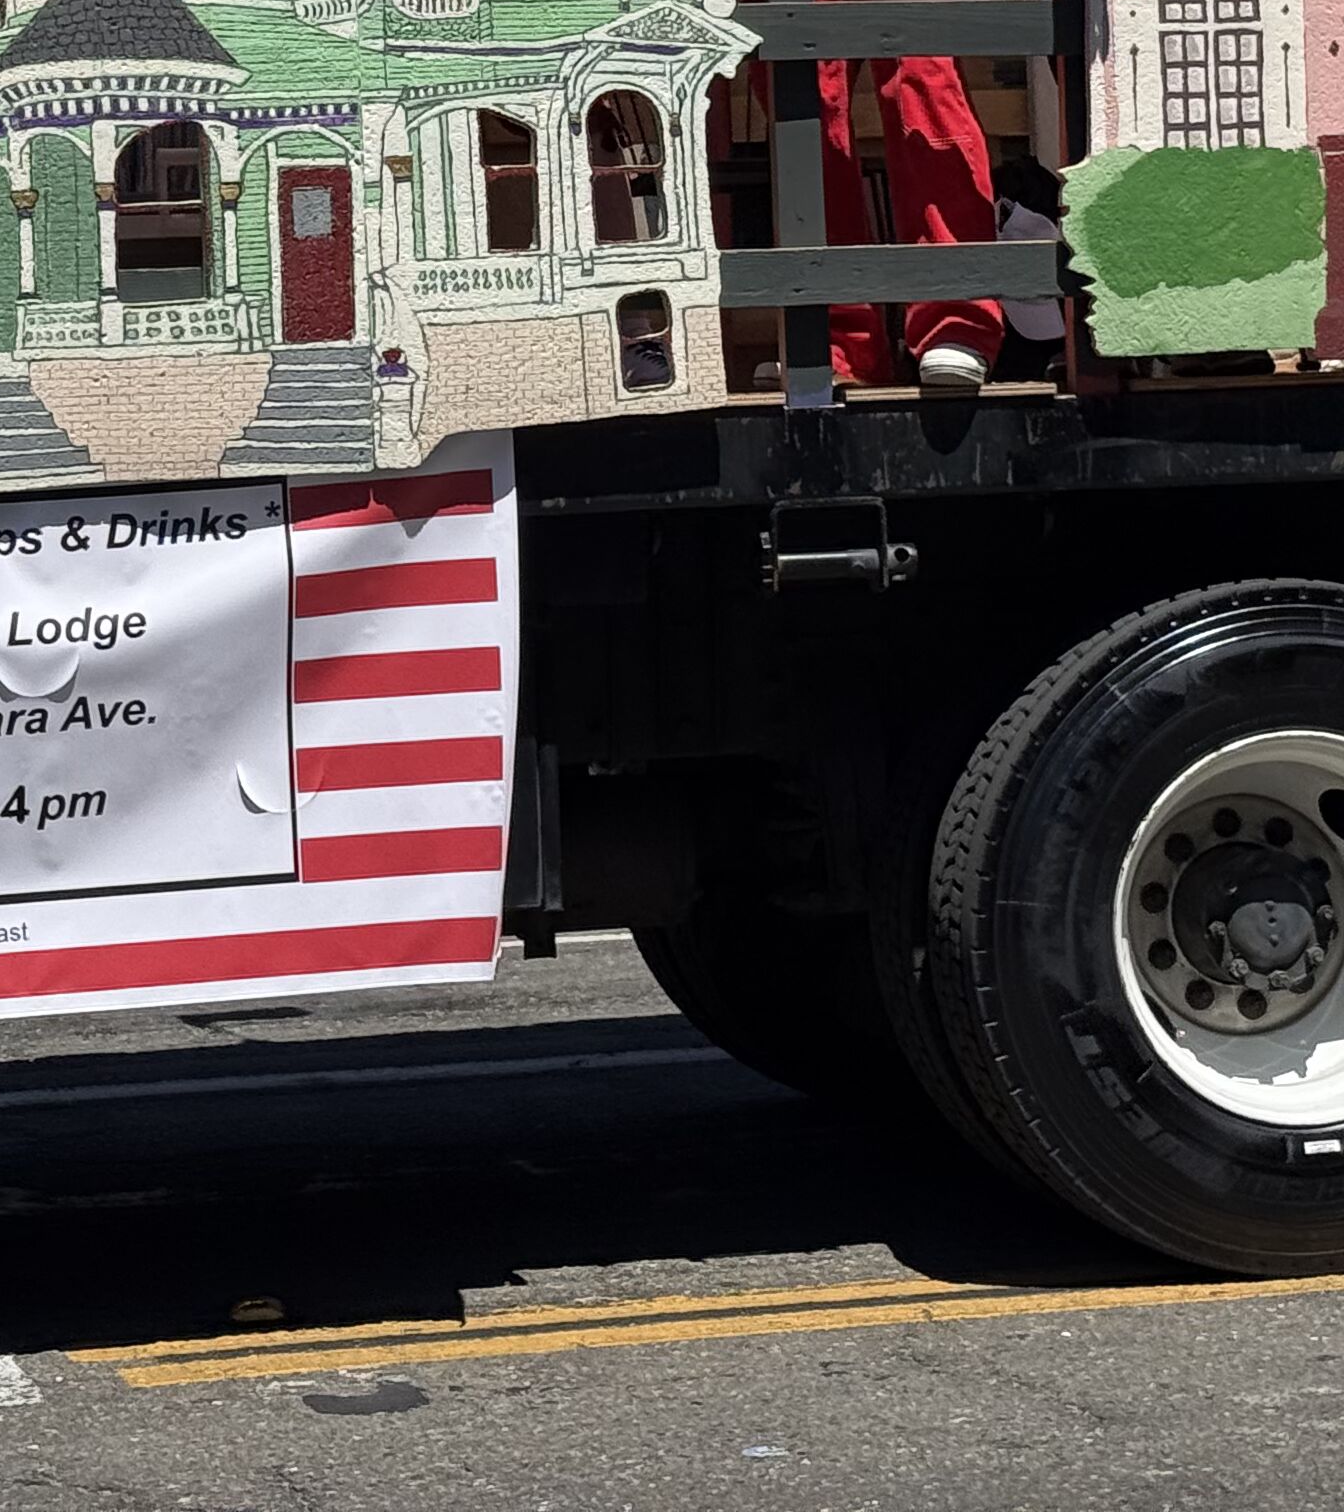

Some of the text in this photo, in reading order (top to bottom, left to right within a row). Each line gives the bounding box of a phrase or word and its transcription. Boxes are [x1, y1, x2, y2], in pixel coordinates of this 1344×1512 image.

[60, 515, 90, 552] &
[106, 506, 249, 550] Drinks
[7, 606, 147, 651] Lodge
[59, 695, 157, 733] Ave.
